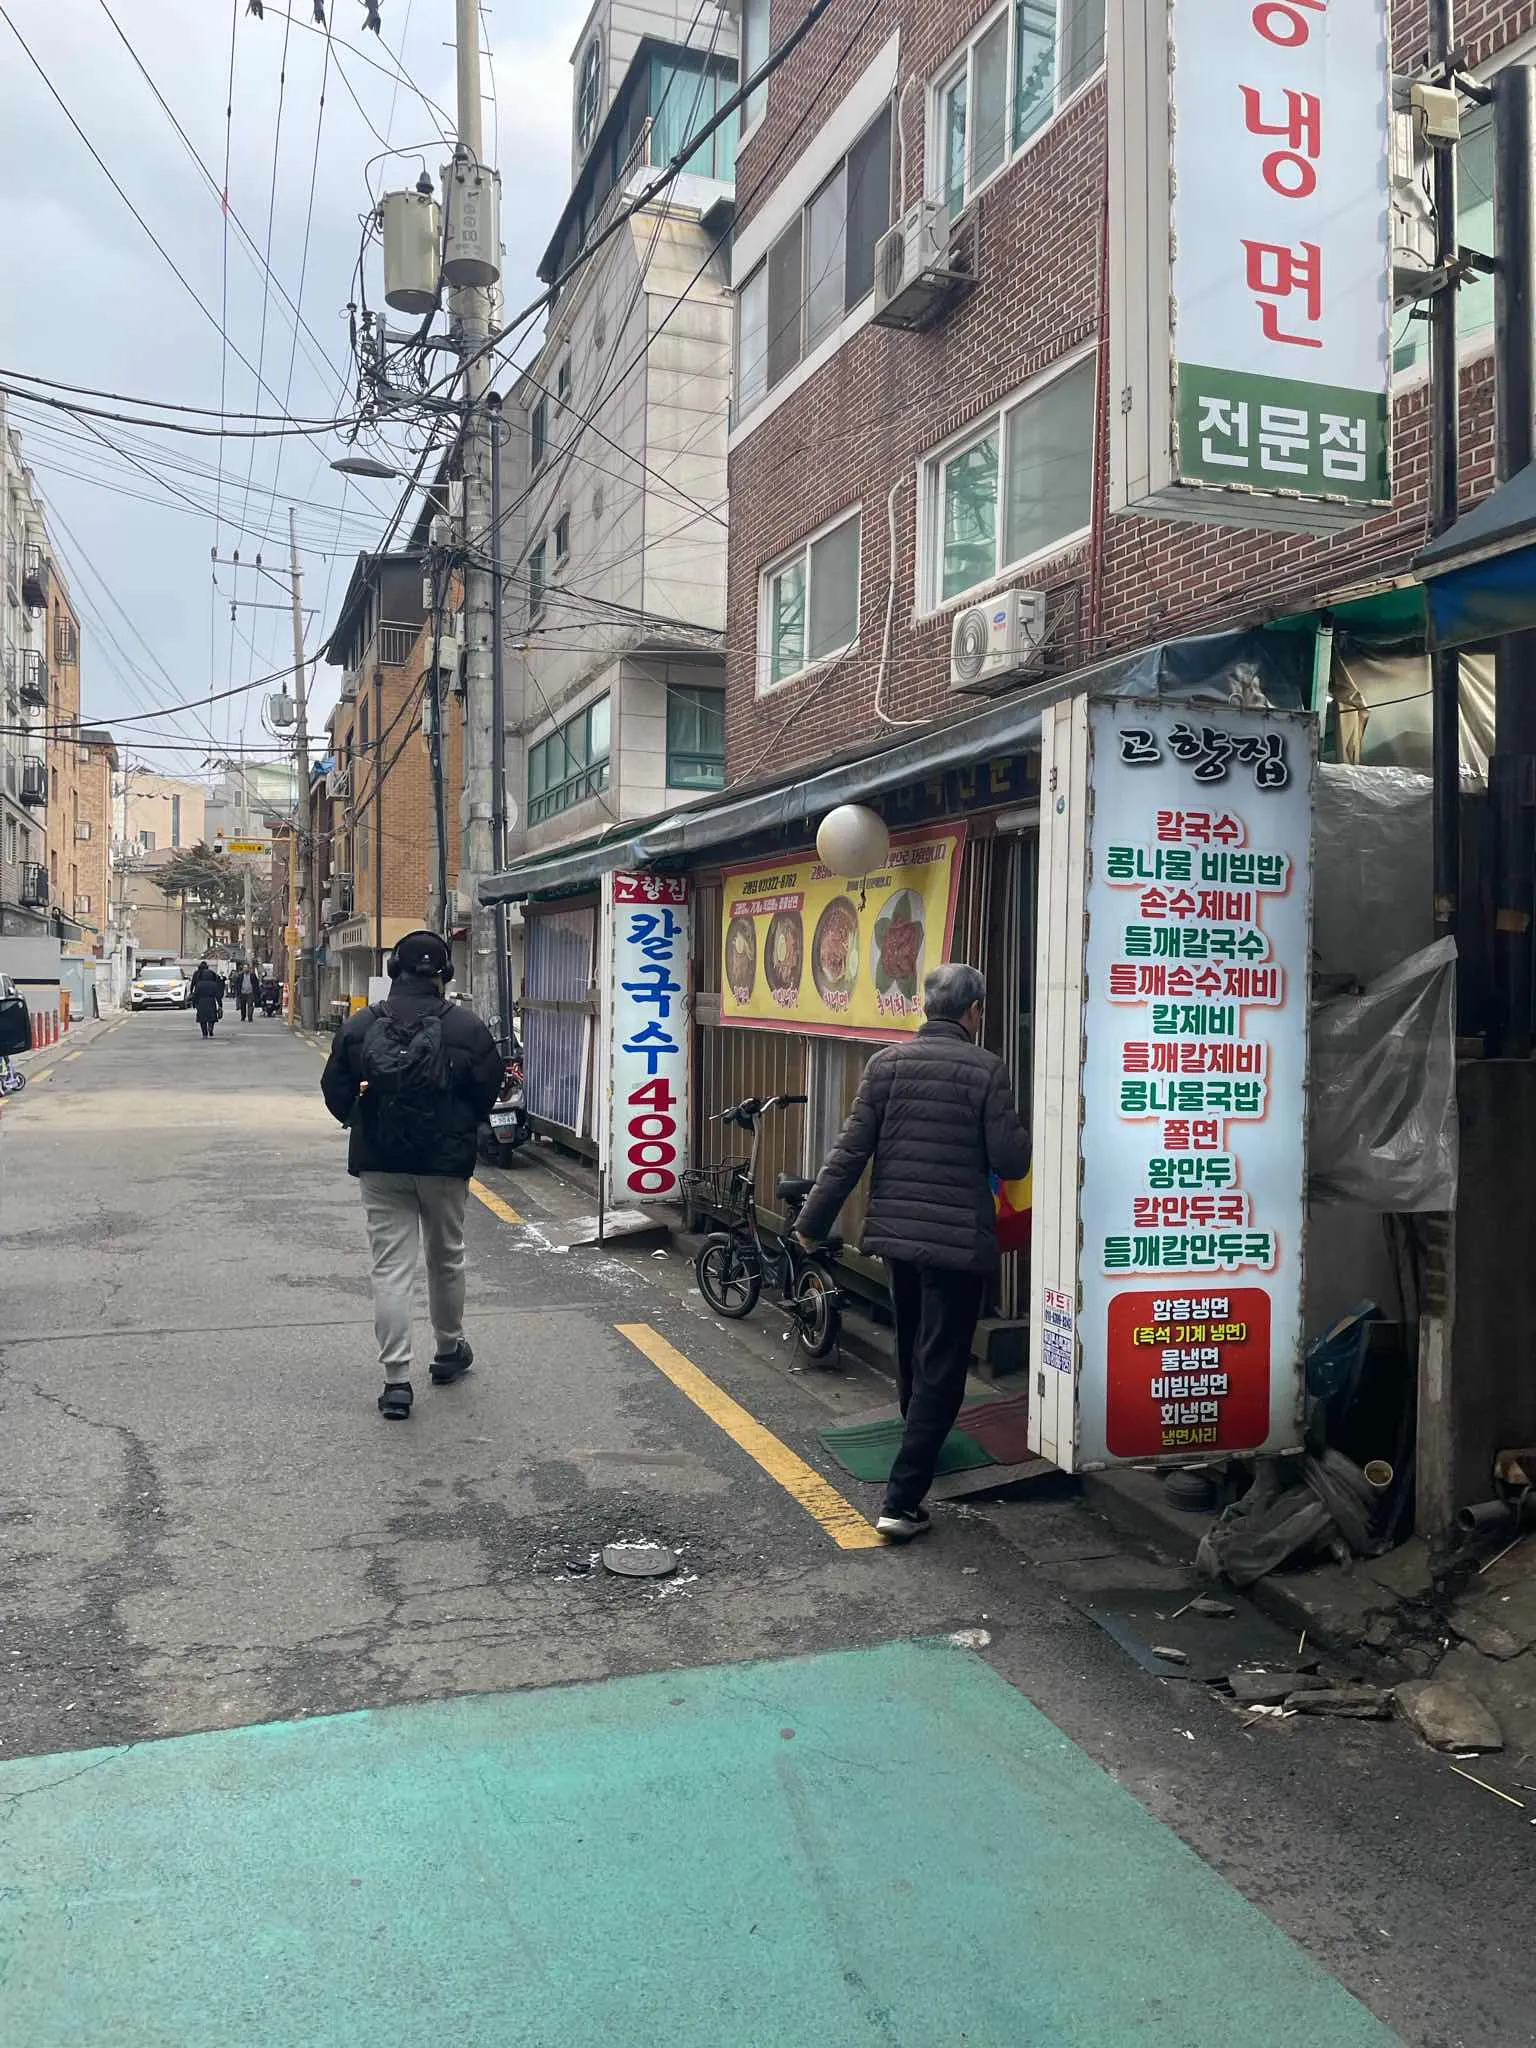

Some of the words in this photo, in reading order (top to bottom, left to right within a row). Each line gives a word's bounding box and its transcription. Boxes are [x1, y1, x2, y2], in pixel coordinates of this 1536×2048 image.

[1197, 396, 1367, 482] 전문점
[1119, 725, 1287, 787] 고향집
[1157, 811, 1239, 845] 칼국수
[1107, 846, 1192, 881] 콩나물
[1201, 851, 1284, 886] 비빔밥
[616, 876, 687, 901] 고향집
[1140, 888, 1252, 921] 손수제비
[1125, 925, 1264, 960] 들깨칼국수
[621, 908, 682, 1075] 칼국수
[1109, 963, 1277, 998] 들깨손수제비
[1152, 1004, 1234, 1036] 칼제비
[1122, 1041, 1262, 1074] 들깨칼제비
[1120, 1081, 1261, 1113] 콩나물국밥
[626, 1078, 677, 1195] 4000
[1163, 1119, 1218, 1150] 쫄면
[1148, 1157, 1231, 1189] 왕만두
[1133, 1195, 1244, 1228] 칼만두국
[1104, 1233, 1270, 1267] 들깨칼만두국
[1152, 1297, 1229, 1321] 함흥냉면
[1133, 1326, 1171, 1345] (즉석
[1175, 1325, 1206, 1343] 기계
[1210, 1323, 1247, 1342] 냉면)
[1161, 1347, 1219, 1371] 물냉면
[1151, 1373, 1228, 1398] 비빔냉면
[1160, 1401, 1218, 1425] 회냉면
[1162, 1427, 1217, 1446] 냉면사리
